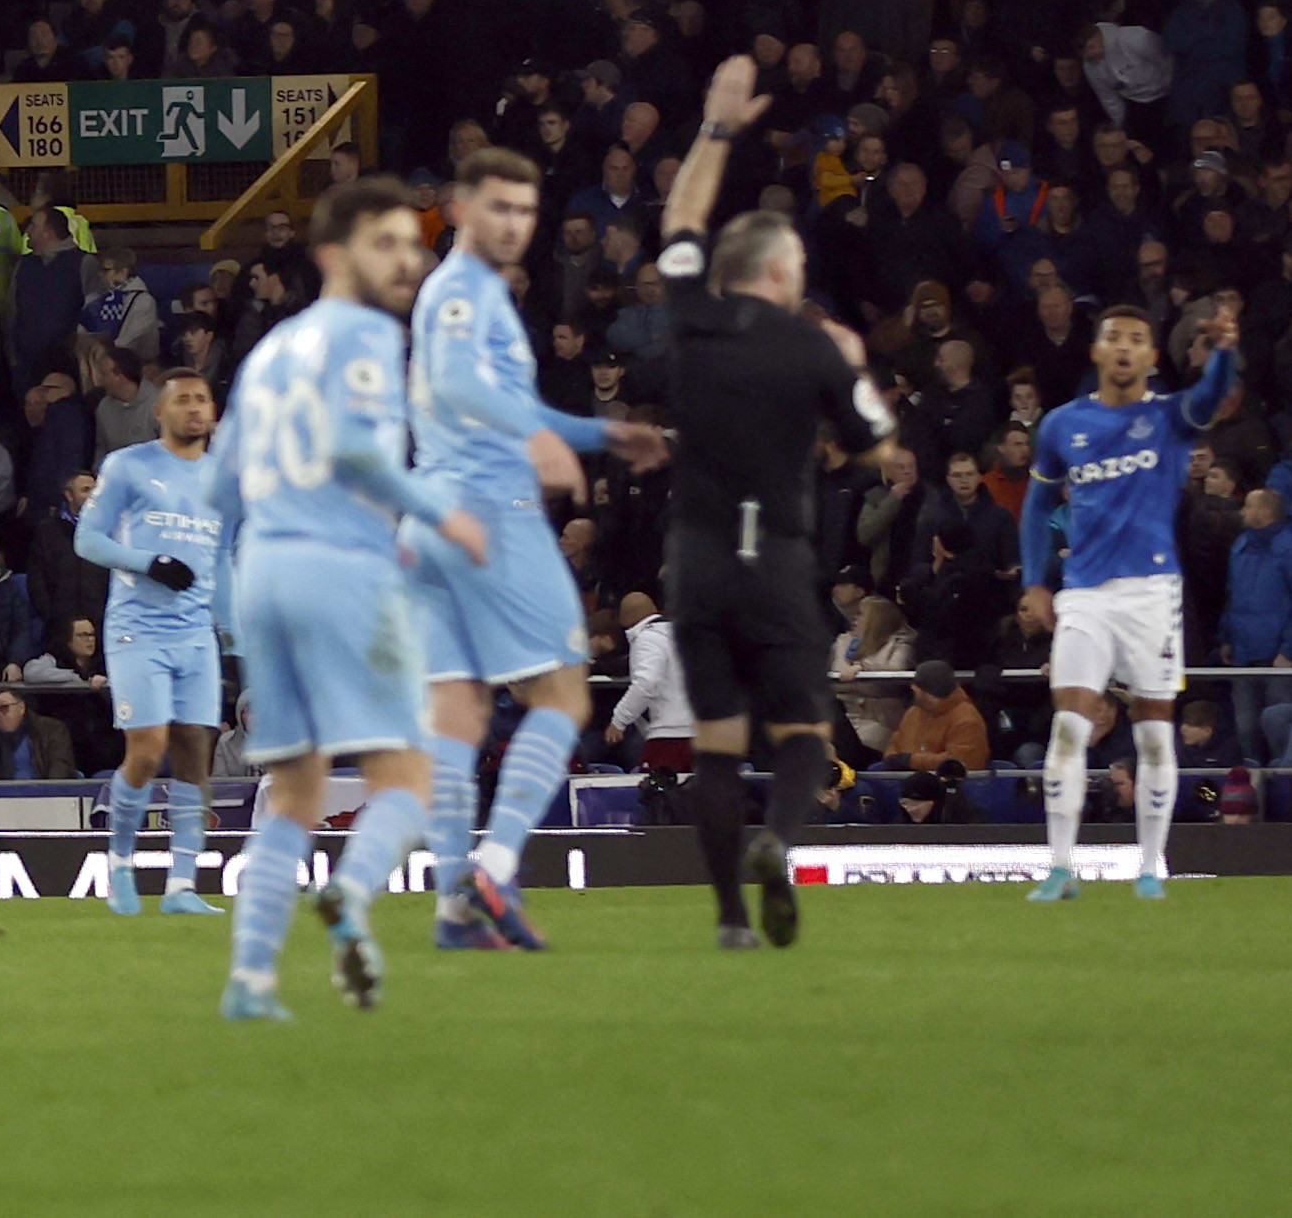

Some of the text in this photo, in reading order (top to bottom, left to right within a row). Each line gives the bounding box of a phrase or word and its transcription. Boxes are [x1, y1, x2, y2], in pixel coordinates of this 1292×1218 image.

[25, 93, 65, 108] SEATS
[276, 88, 325, 103] SEATS
[27, 115, 63, 135] 166
[79, 108, 149, 138] EXIT
[281, 106, 317, 125] 151
[27, 137, 63, 157] 180
[239, 378, 335, 501] 20
[1068, 449, 1159, 485] CAZOO
